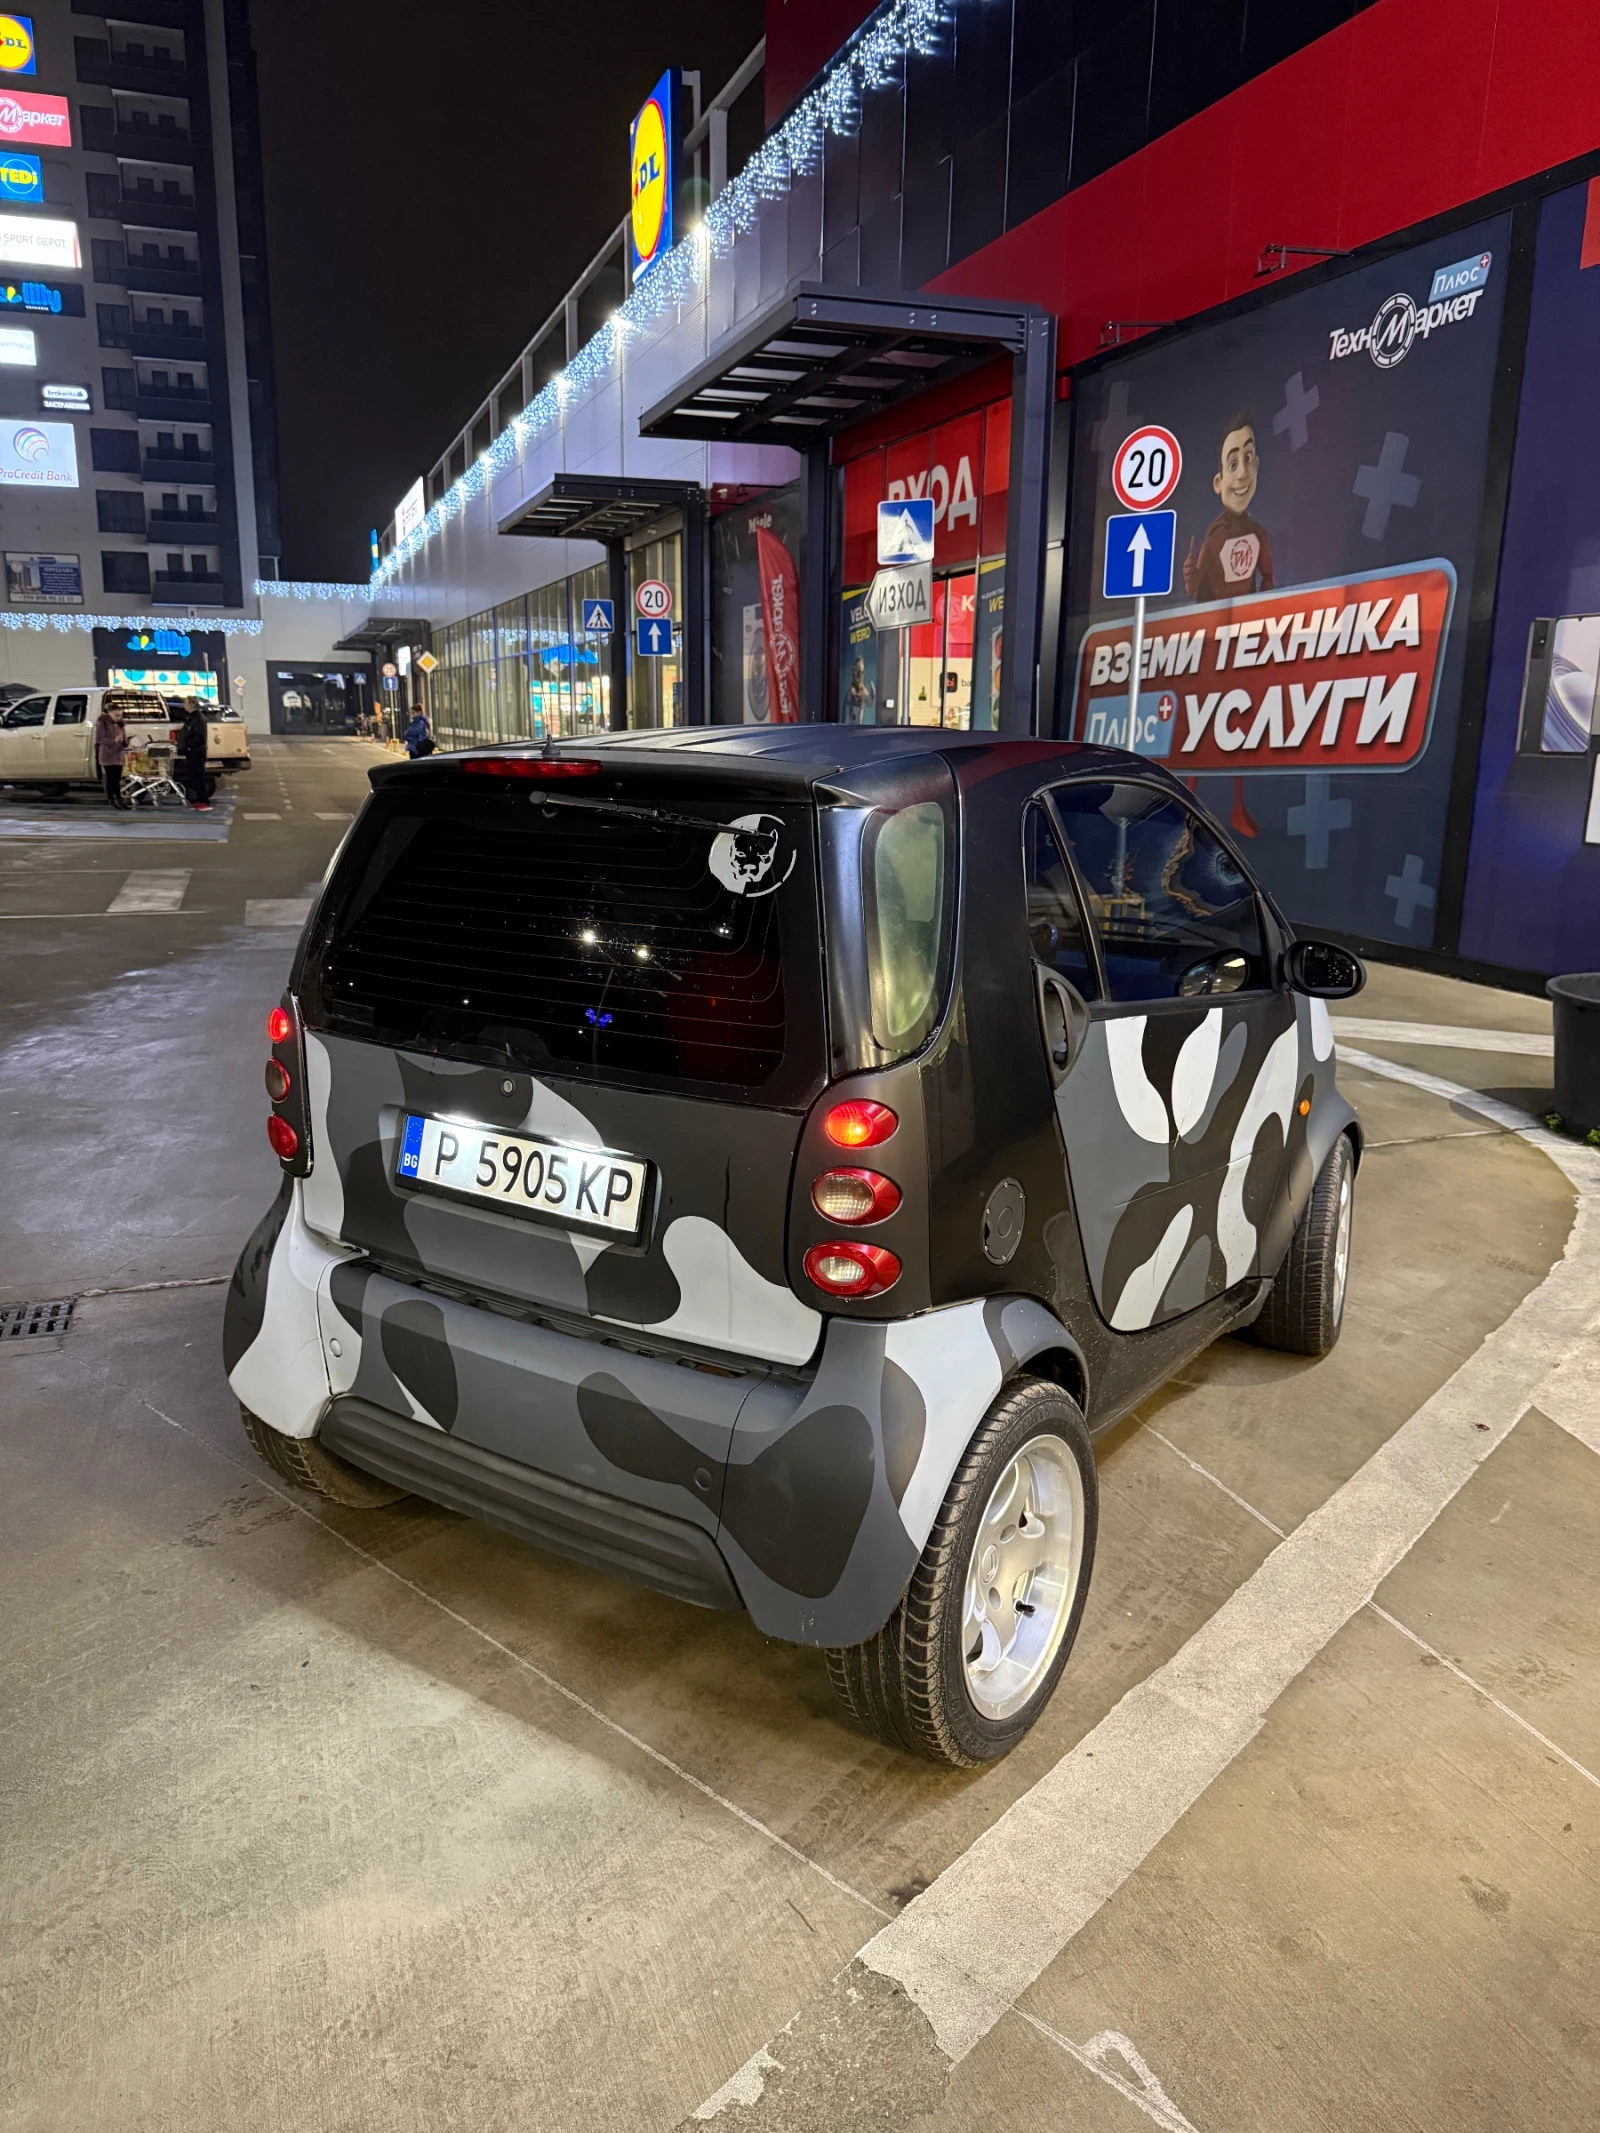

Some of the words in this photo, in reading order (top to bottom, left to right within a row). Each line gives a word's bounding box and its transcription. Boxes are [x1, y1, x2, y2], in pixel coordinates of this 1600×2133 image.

[3, 233, 34, 245] SPORT
[36, 236, 66, 248] DEPOT
[46, 470, 73, 482] Bank
[1128, 448, 1166, 489] 20
[644, 590, 664, 608] 20
[879, 578, 926, 615] ИЗХОД
[1089, 629, 1206, 687] ВЗЕМИ
[1214, 592, 1420, 671] ТЕХНИКА
[1180, 671, 1418, 753] УСЛУГИ
[403, 1152, 418, 1168] BG
[475, 1140, 569, 1205] 5905
